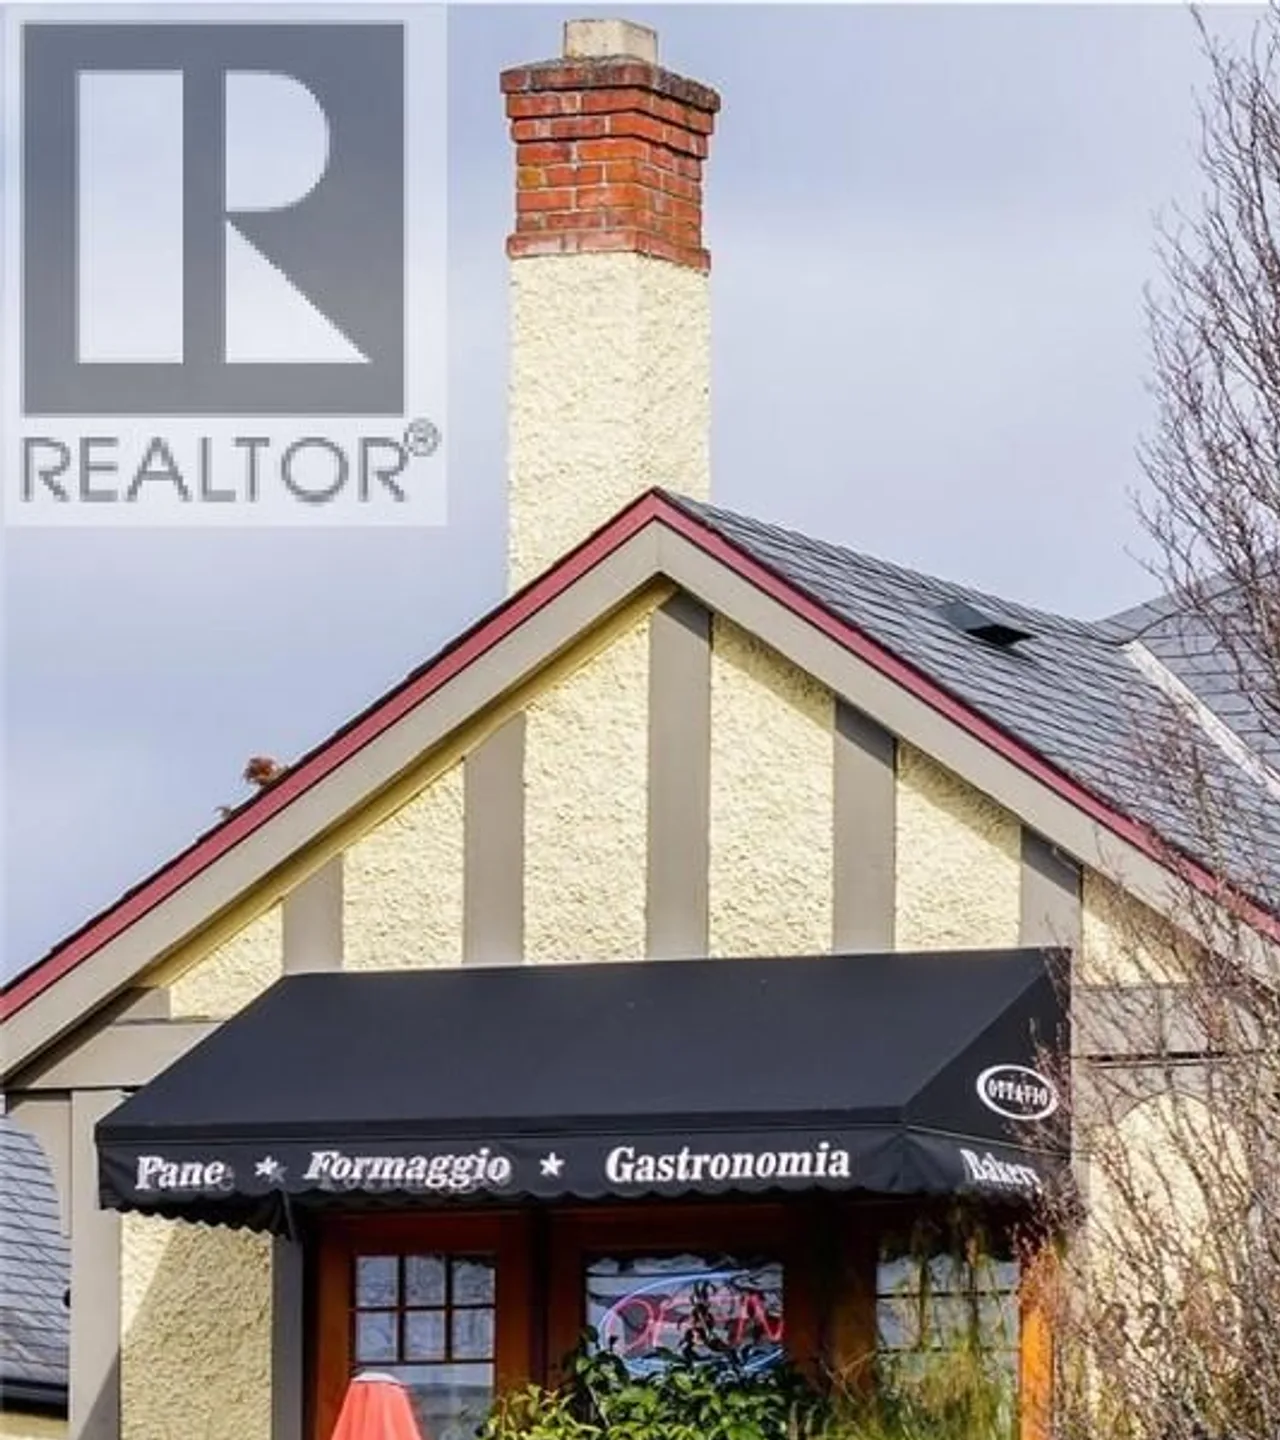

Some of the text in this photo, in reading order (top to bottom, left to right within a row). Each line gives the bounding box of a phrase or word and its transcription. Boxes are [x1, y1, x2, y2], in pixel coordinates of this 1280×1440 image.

[134, 1141, 851, 1191] Pane Formaggio Gastronomia
